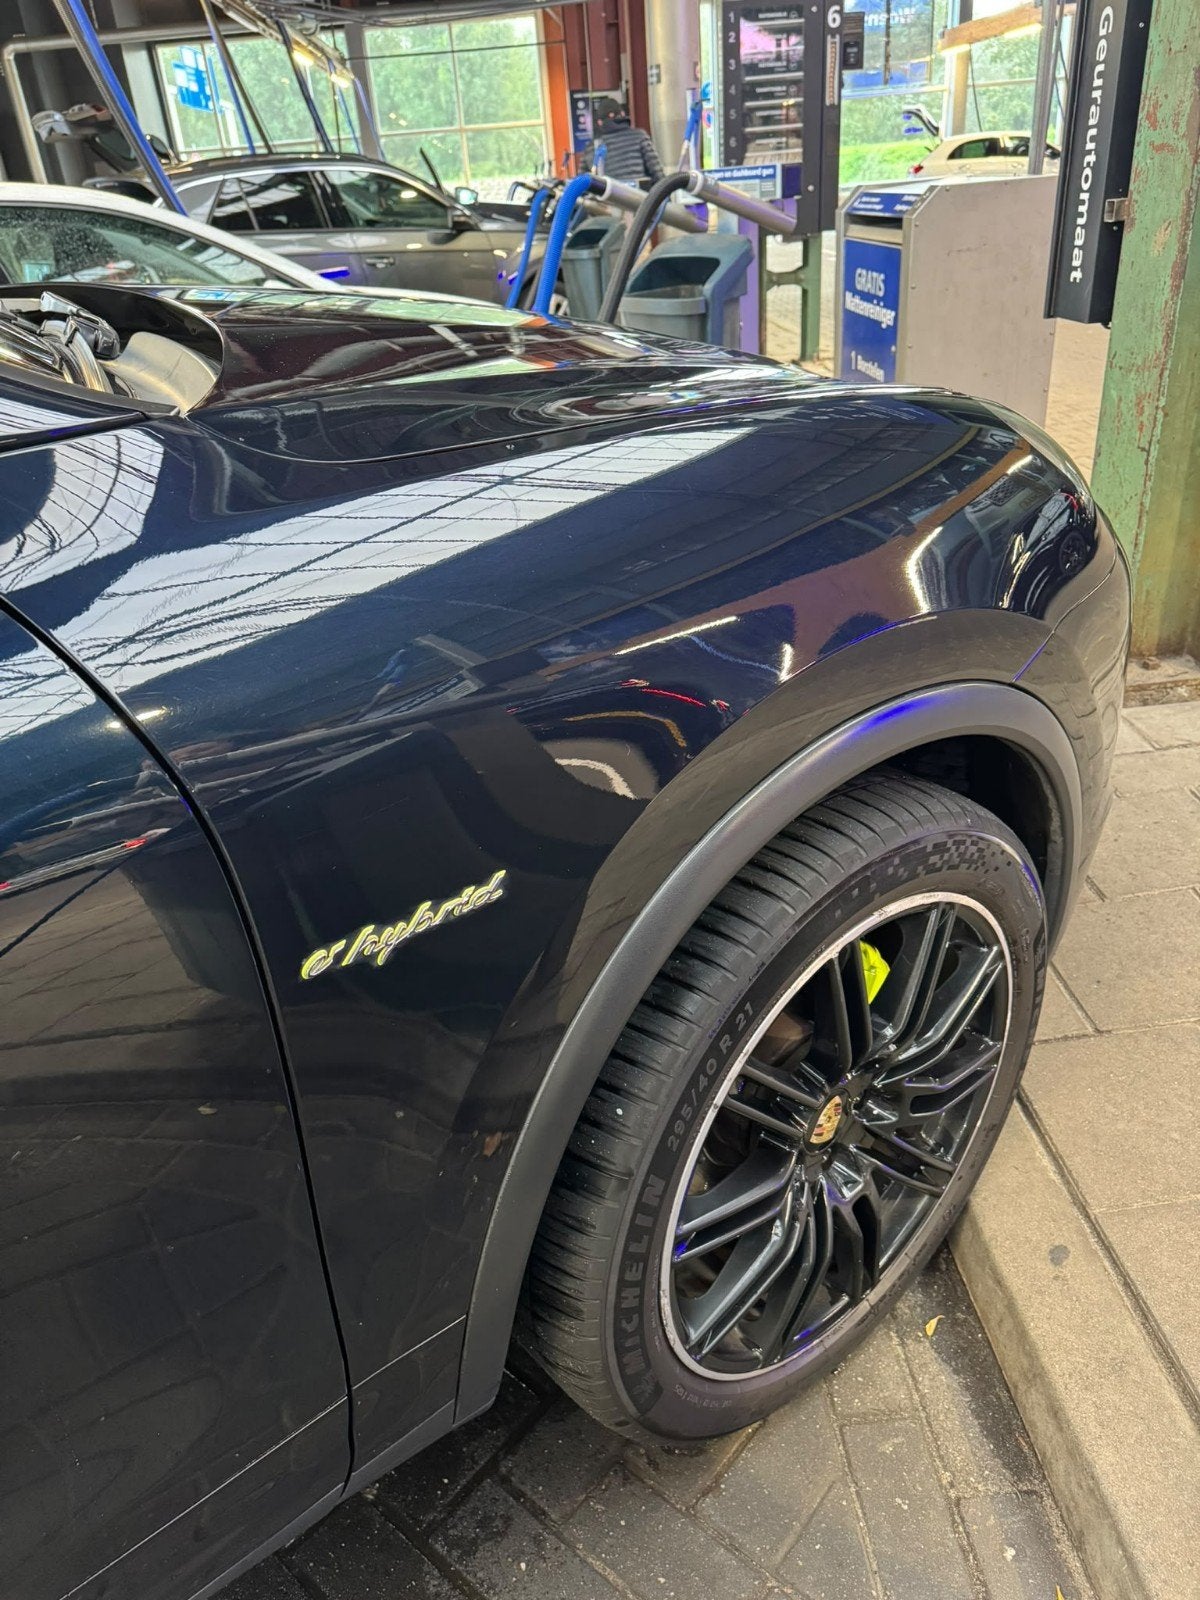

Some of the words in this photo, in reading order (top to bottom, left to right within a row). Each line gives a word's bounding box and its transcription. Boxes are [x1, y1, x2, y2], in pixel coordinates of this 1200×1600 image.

[728, 11, 735, 23] 1
[827, 5, 841, 28] 6
[728, 32, 736, 43] 2
[728, 59, 736, 70] 3
[728, 84, 736, 95] 4
[729, 109, 736, 119] 5
[729, 136, 737, 147] 6
[1069, 5, 1114, 283] Geurautomaat
[855, 267, 885, 297] GRATIS
[666, 1057, 718, 1153] 295/40
[718, 1034, 733, 1055] R
[735, 1001, 754, 1031] 21
[619, 1173, 667, 1377] MICHELIN
